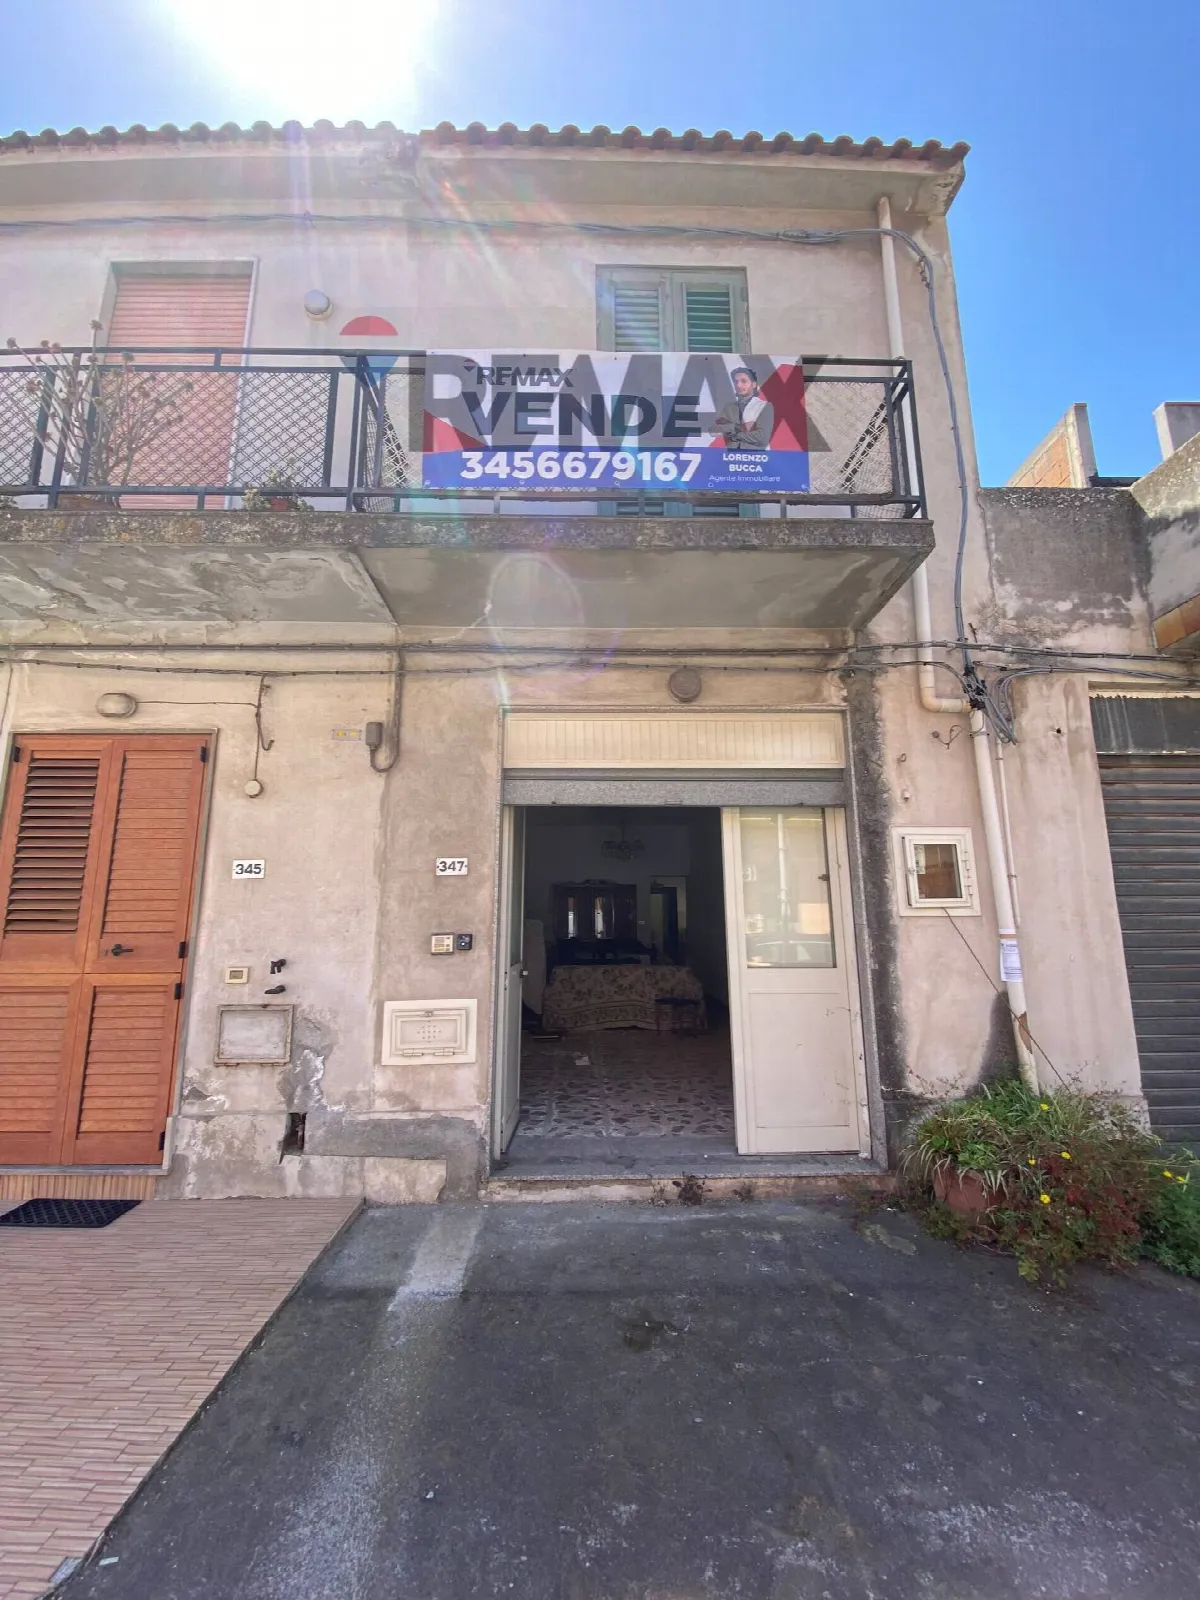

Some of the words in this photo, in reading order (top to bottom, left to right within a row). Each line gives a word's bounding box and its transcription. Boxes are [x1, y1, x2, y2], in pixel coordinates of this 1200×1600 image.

[461, 391, 702, 437] VENDE
[722, 453, 769, 462] LORENZO
[460, 451, 702, 481] 3456679167
[728, 464, 763, 472] BUCCA
[235, 863, 262, 875] 345
[438, 860, 465, 872] 347
